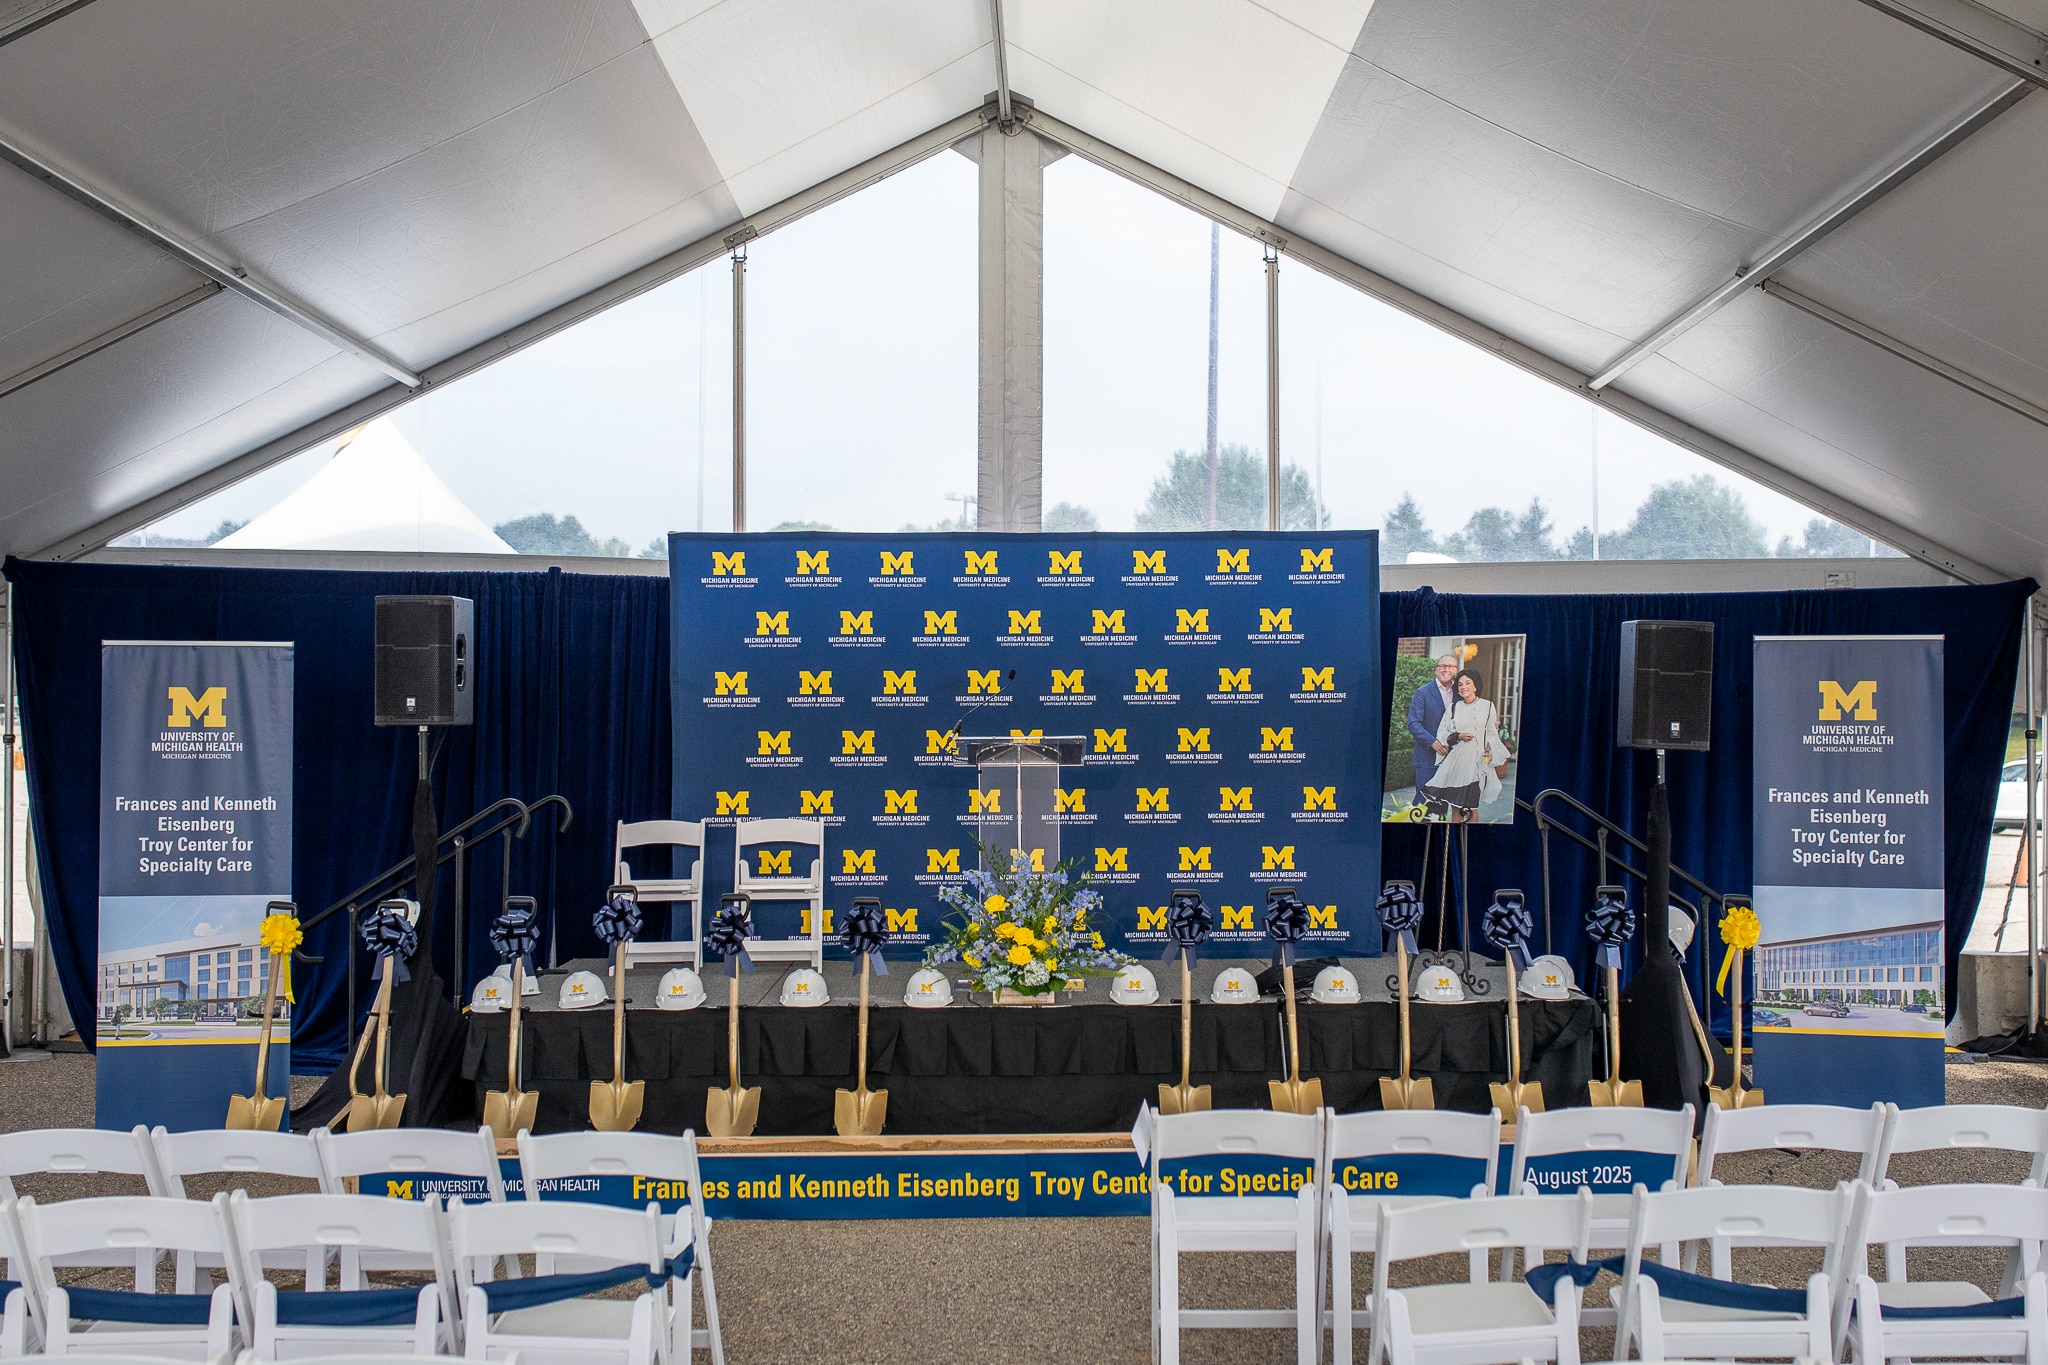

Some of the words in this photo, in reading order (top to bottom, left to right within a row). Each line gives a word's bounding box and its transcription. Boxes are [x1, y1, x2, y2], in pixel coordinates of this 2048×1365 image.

[712, 552, 745, 575] M
[797, 551, 829, 575] M
[881, 551, 914, 575] M
[965, 551, 998, 574] M
[1049, 551, 1082, 574] M
[1133, 551, 1166, 574] M
[1217, 549, 1249, 573] M
[1301, 549, 1333, 572] M
[756, 611, 789, 635] M
[840, 611, 873, 635] M
[923, 611, 957, 635] M
[1008, 610, 1041, 634] M
[1092, 609, 1125, 633] M
[1176, 609, 1209, 633] M
[1259, 608, 1292, 632] M
[715, 671, 749, 695] M
[883, 670, 917, 695] M
[1135, 669, 1169, 693] M
[1219, 667, 1251, 692] M
[1301, 667, 1335, 691] M
[168, 687, 226, 728] M
[1819, 681, 1877, 720] M
[161, 732, 219, 741] UNIVERSITY
[222, 732, 235, 741] OF
[1177, 727, 1211, 752] M
[1803, 735, 1853, 745] MICHIGAN
[1857, 736, 1894, 745] HEALTH
[1812, 726, 1870, 735] UNIVERSITY
[1873, 726, 1886, 734] OF
[152, 742, 202, 752] MICHIGAN
[206, 742, 243, 752] HEALTH
[841, 730, 875, 755] M
[116, 797, 177, 811] Frances
[182, 796, 209, 810] and
[214, 796, 276, 810] Kenneth
[884, 789, 918, 814] M
[1303, 786, 1337, 811] M
[1768, 788, 1828, 803] Frances
[1833, 789, 1860, 804] and
[1866, 789, 1929, 804] Kenneth
[158, 817, 235, 834] Eisenberg
[1810, 809, 1886, 827] Eisenberg
[139, 838, 173, 855] Troy
[178, 837, 226, 851] Center
[232, 837, 253, 851] for
[1792, 829, 1825, 846] Troy
[1830, 829, 1880, 844] Center
[1884, 830, 1905, 845] for
[139, 858, 212, 876] Specialty
[216, 858, 252, 872] Care
[842, 849, 876, 874] M
[1261, 845, 1295, 870] M
[1793, 849, 1864, 867] Specialty
[1869, 850, 1904, 865] Care
[884, 908, 918, 933] M
[1221, 905, 1254, 930] M
[572, 984, 584, 993] M
[671, 985, 683, 994] M
[796, 983, 808, 992] M
[921, 983, 933, 993] M
[1129, 980, 1141, 989] M
[1227, 981, 1239, 990] M
[1332, 979, 1345, 989] M
[1438, 978, 1450, 987] M
[1545, 975, 1557, 984] M
[485, 989, 497, 997] M
[387, 1179, 413, 1200] M
[421, 1180, 485, 1192] UNIVERSITY
[502, 1179, 558, 1192] MICGAN
[560, 1178, 600, 1192] HEALTH
[633, 1175, 730, 1200] Franes
[737, 1174, 781, 1200] and
[789, 1173, 890, 1199] Kenneth
[898, 1171, 1020, 1202] Eisenberg
[1030, 1171, 1085, 1201] Troy
[1179, 1168, 1213, 1194] for
[1220, 1166, 1335, 1198] Special
[1343, 1165, 1399, 1190] Care
[1525, 1167, 1588, 1189] August
[1592, 1166, 1632, 1184] 2025
